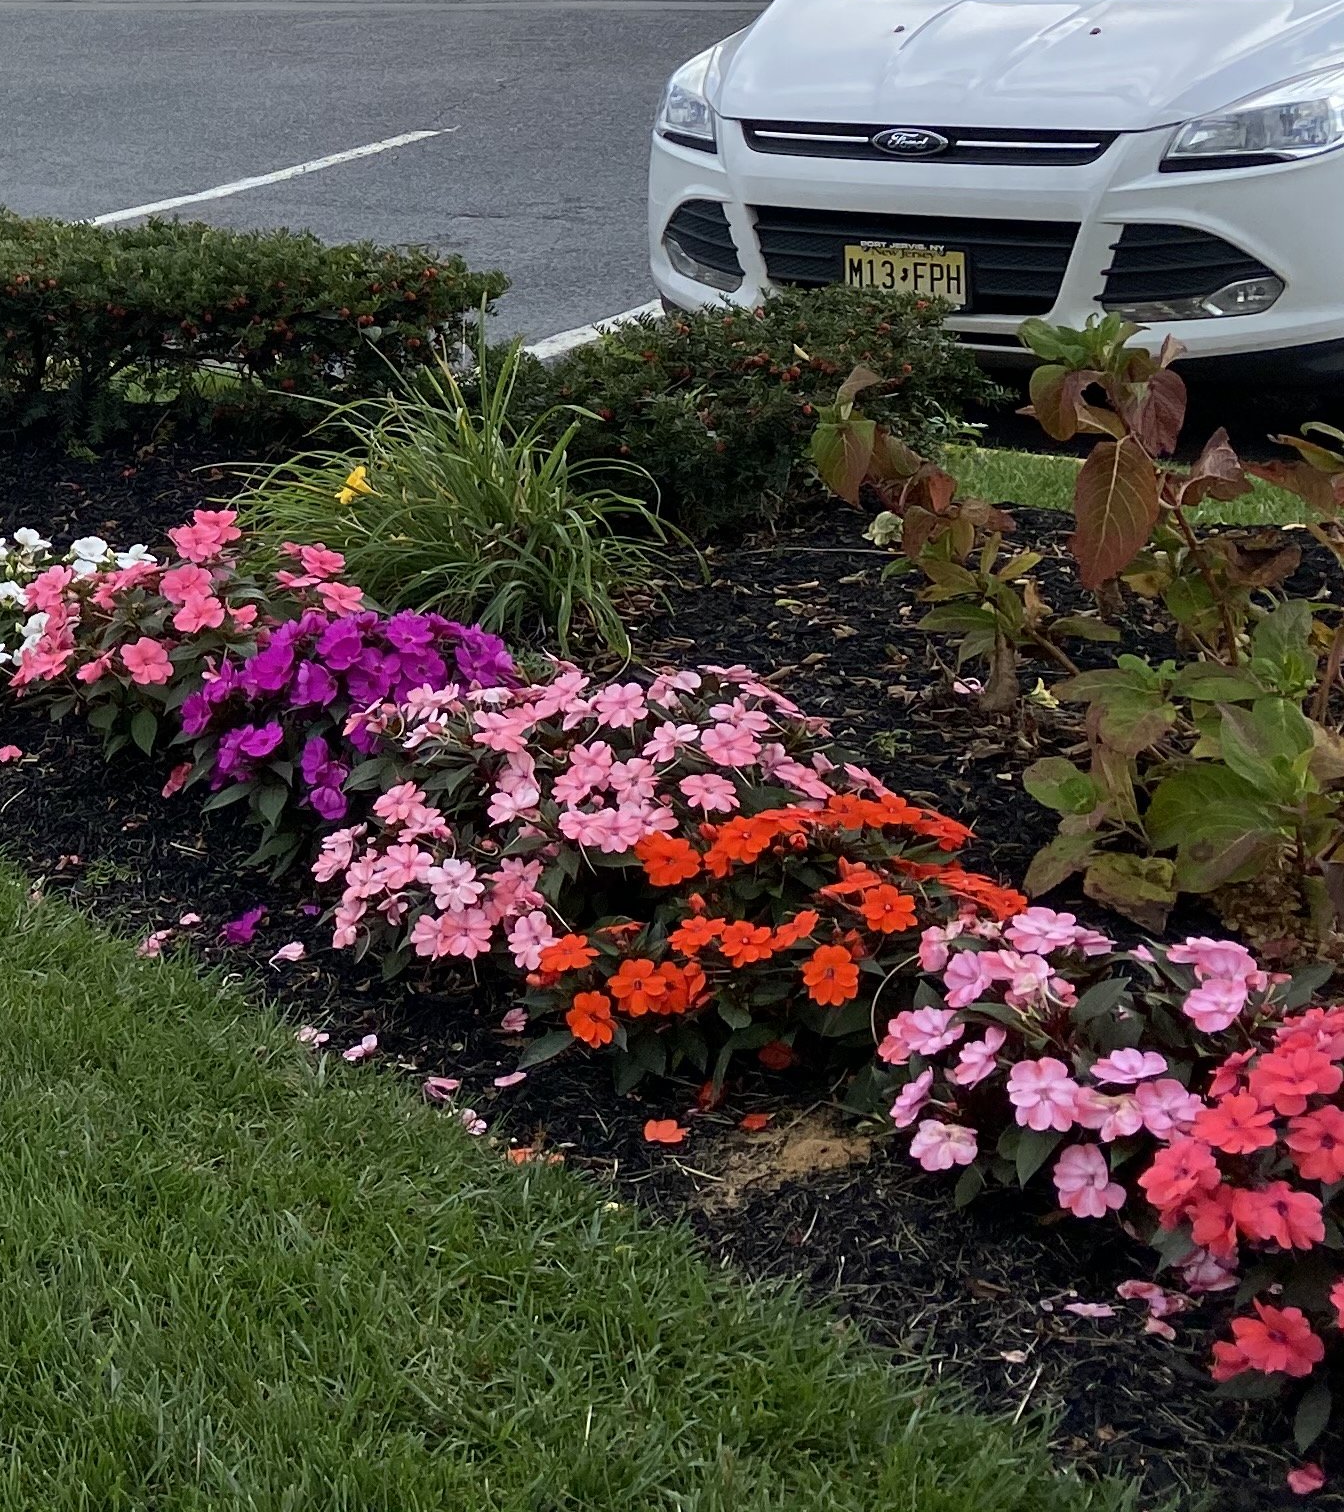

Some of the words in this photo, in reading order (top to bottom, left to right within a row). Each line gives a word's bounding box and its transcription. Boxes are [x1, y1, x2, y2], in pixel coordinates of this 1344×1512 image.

[888, 132, 929, 149] Ford
[860, 240, 887, 248] PORT
[929, 244, 945, 252] NY
[872, 247, 898, 257] New
[900, 248, 936, 261] Jersey
[849, 258, 895, 290] M13
[913, 262, 961, 295] FPH
